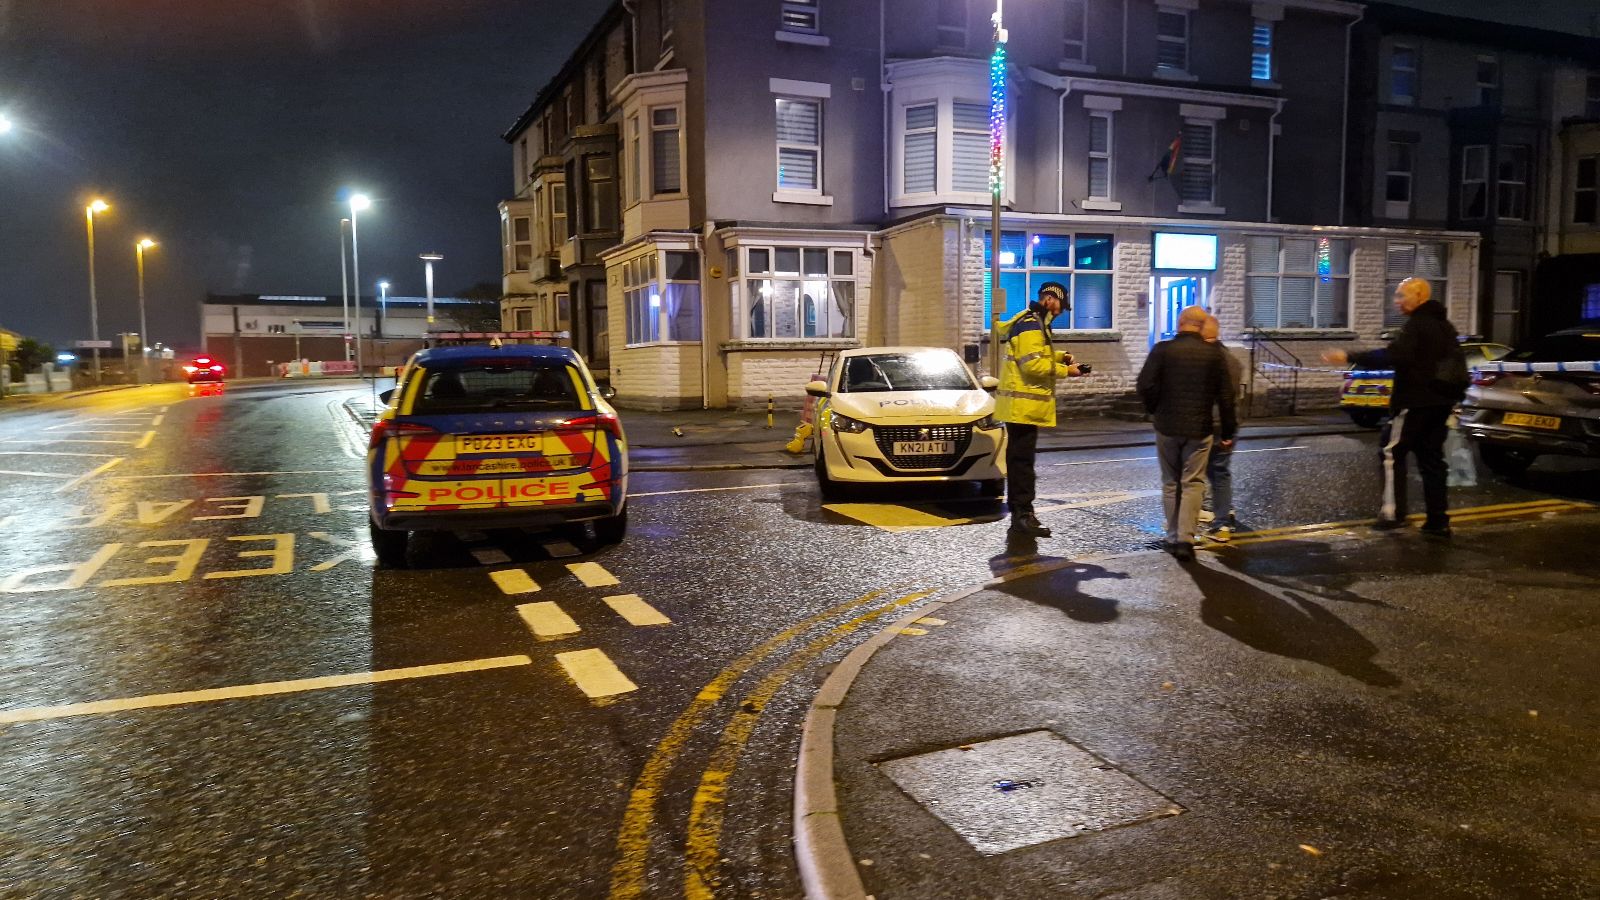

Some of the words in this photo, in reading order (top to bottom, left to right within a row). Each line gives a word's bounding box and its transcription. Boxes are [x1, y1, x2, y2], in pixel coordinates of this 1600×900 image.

[507, 435, 536, 449] EXG
[900, 442, 925, 453] KN21
[927, 442, 948, 453] ATU
[428, 482, 570, 501] POLICE
